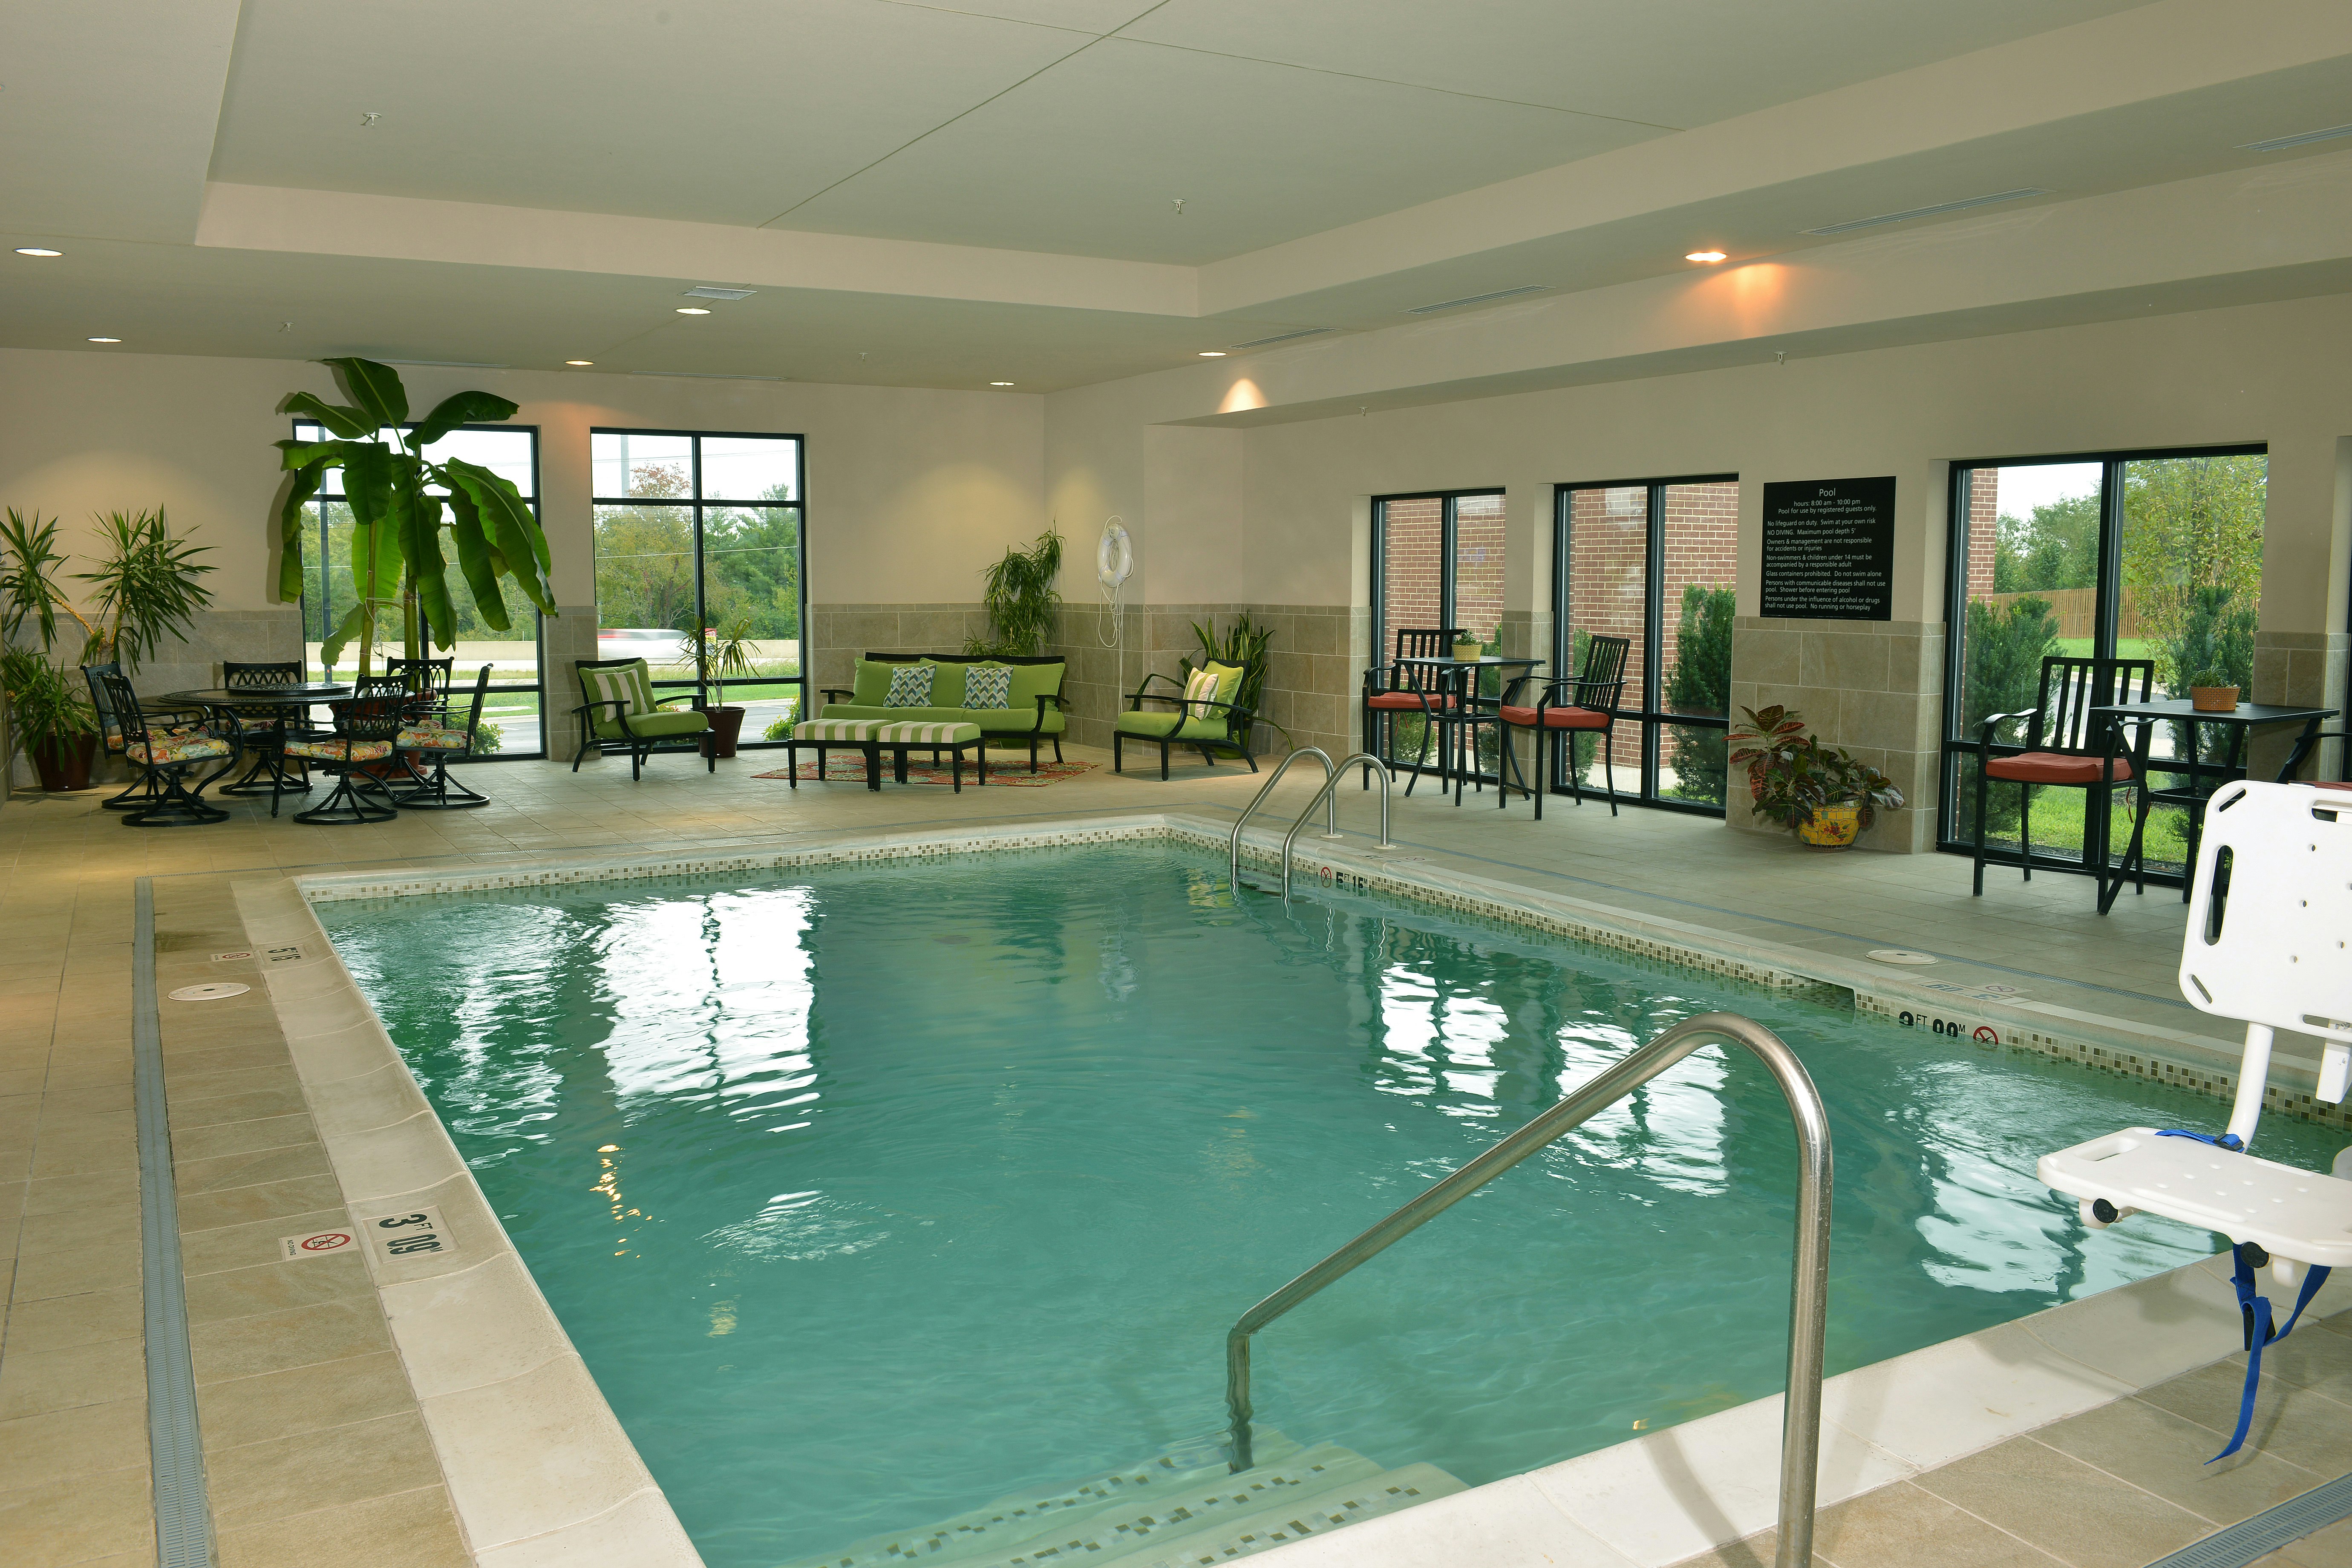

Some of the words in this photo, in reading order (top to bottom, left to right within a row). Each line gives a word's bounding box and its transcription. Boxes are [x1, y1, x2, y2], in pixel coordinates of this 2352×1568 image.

[1819, 487, 1836, 497] Pool
[379, 1213, 428, 1228] 3
[414, 1222, 433, 1231] FT
